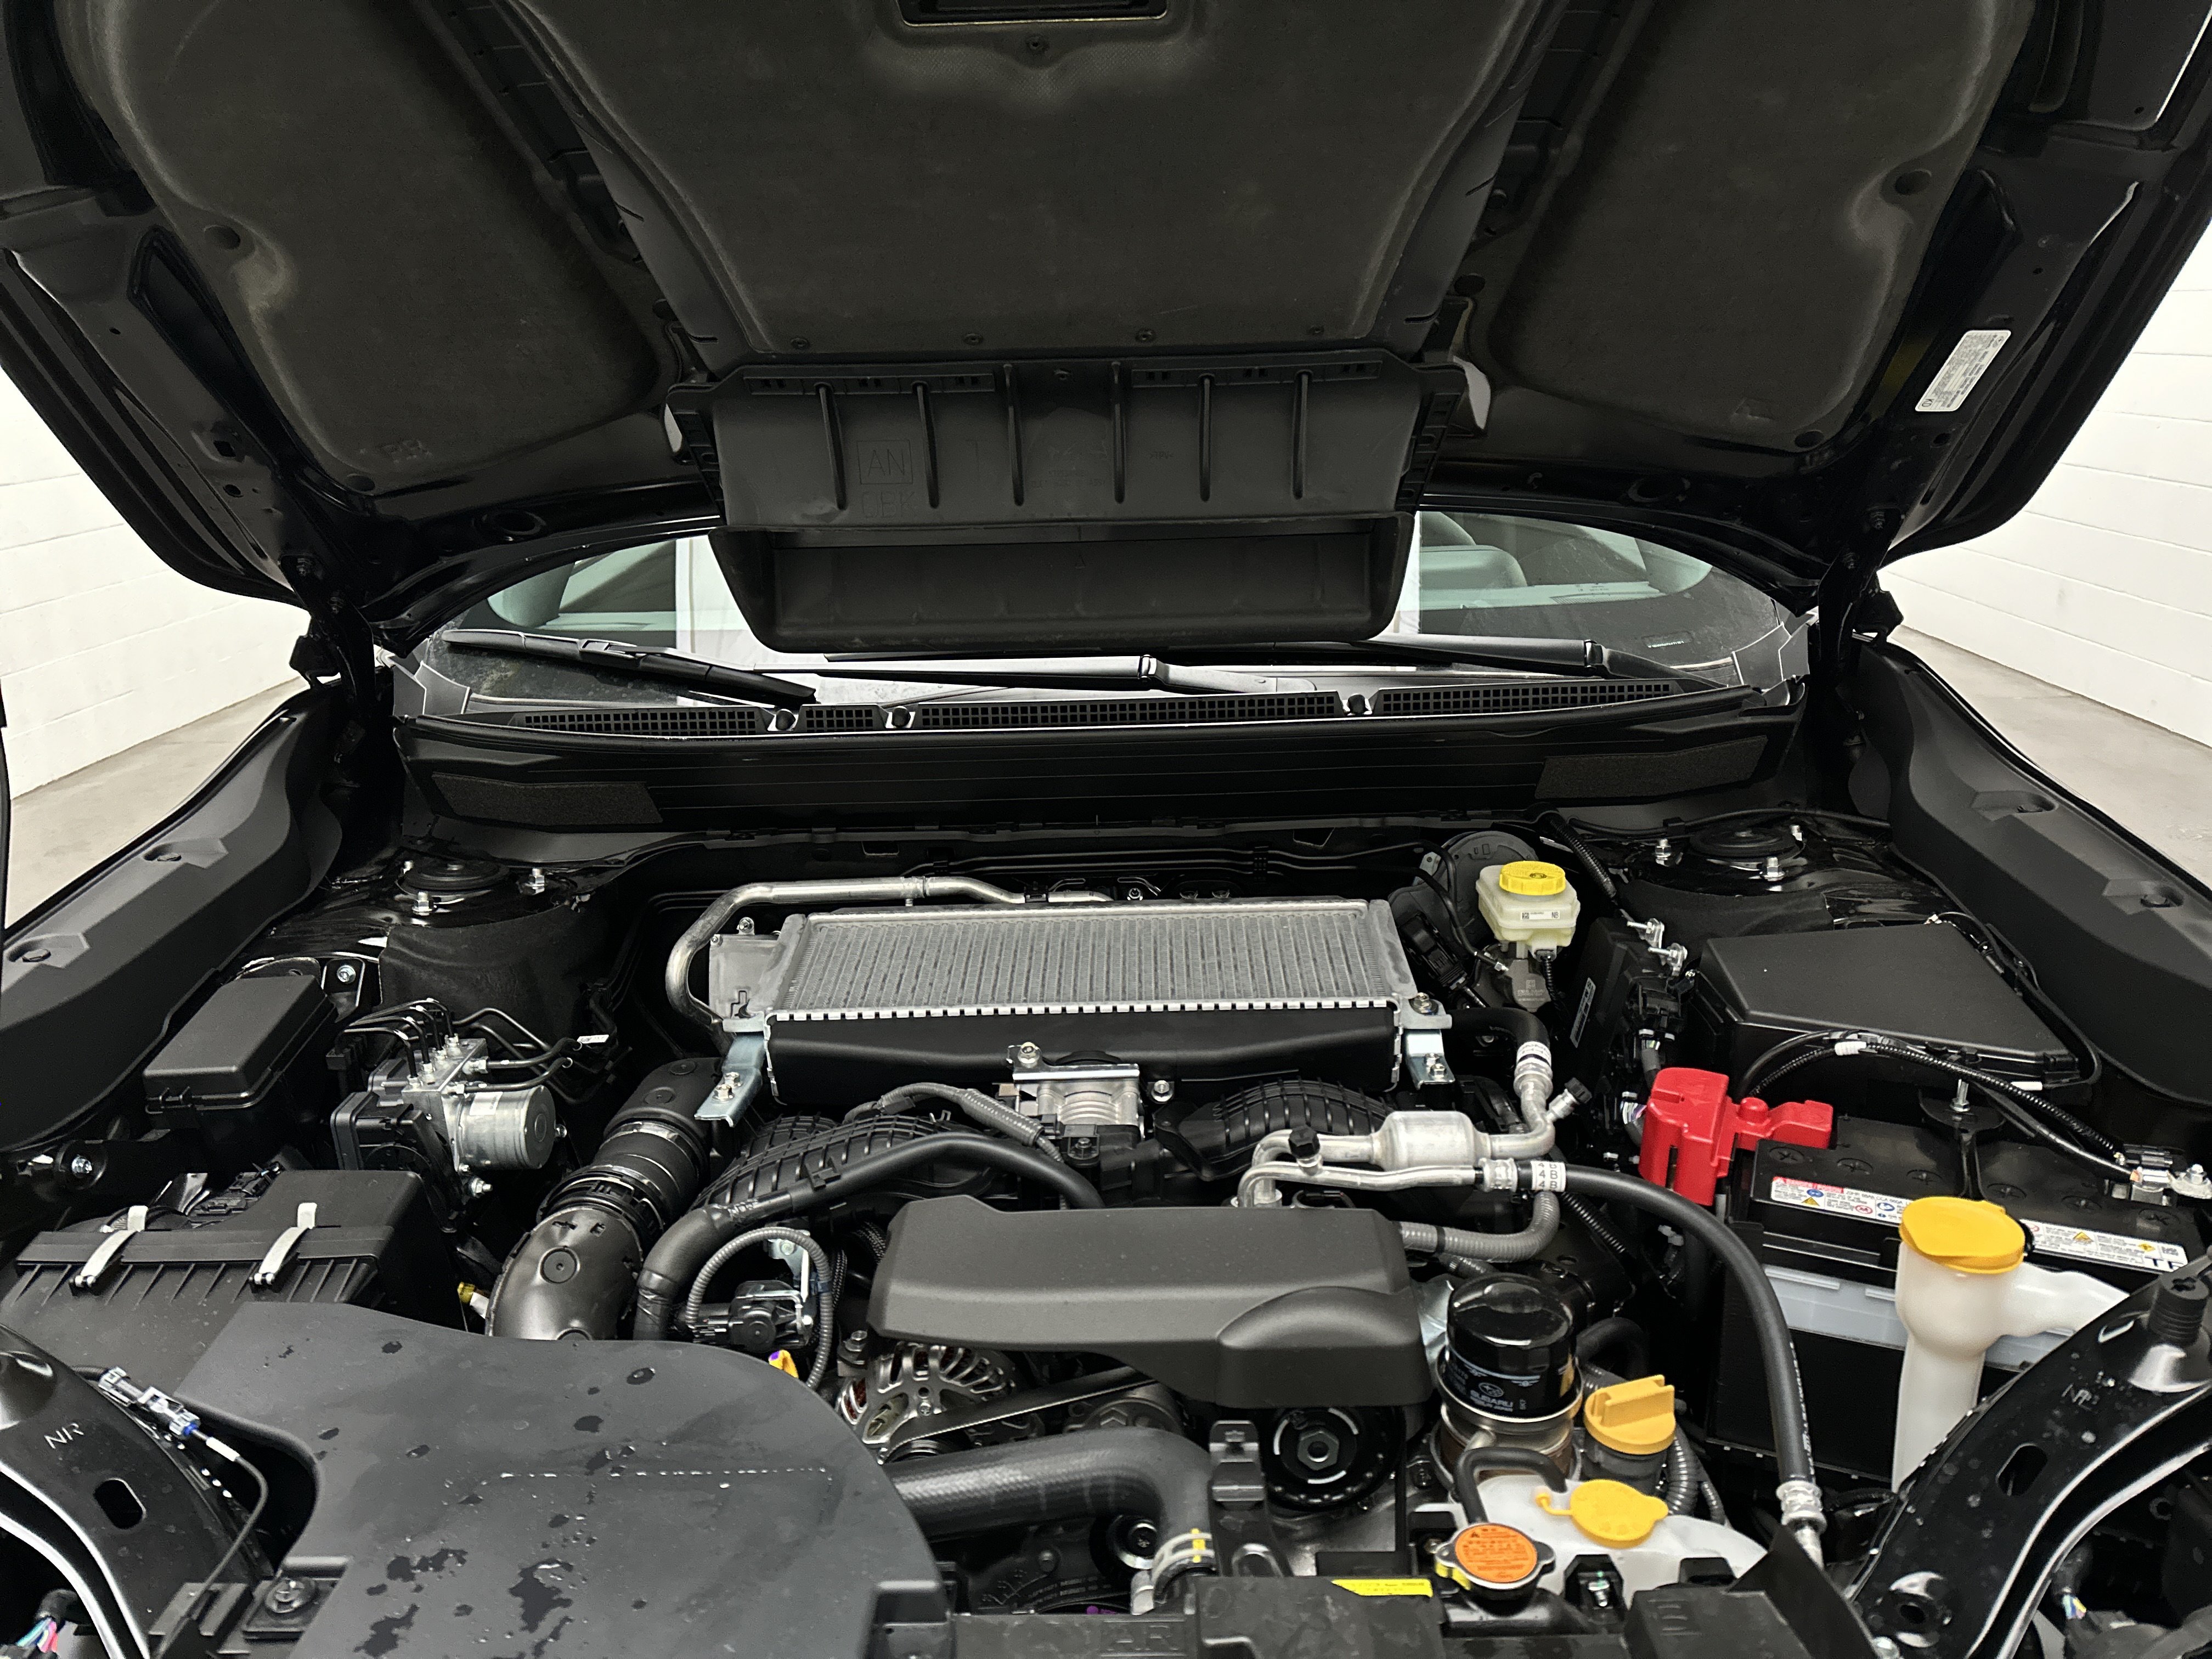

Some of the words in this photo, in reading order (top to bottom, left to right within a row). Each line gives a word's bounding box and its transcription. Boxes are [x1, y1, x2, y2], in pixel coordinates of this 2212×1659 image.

[867, 448, 906, 477] AN
[1470, 1389, 1514, 1408] SUBARU
[44, 1421, 84, 1450] NR
